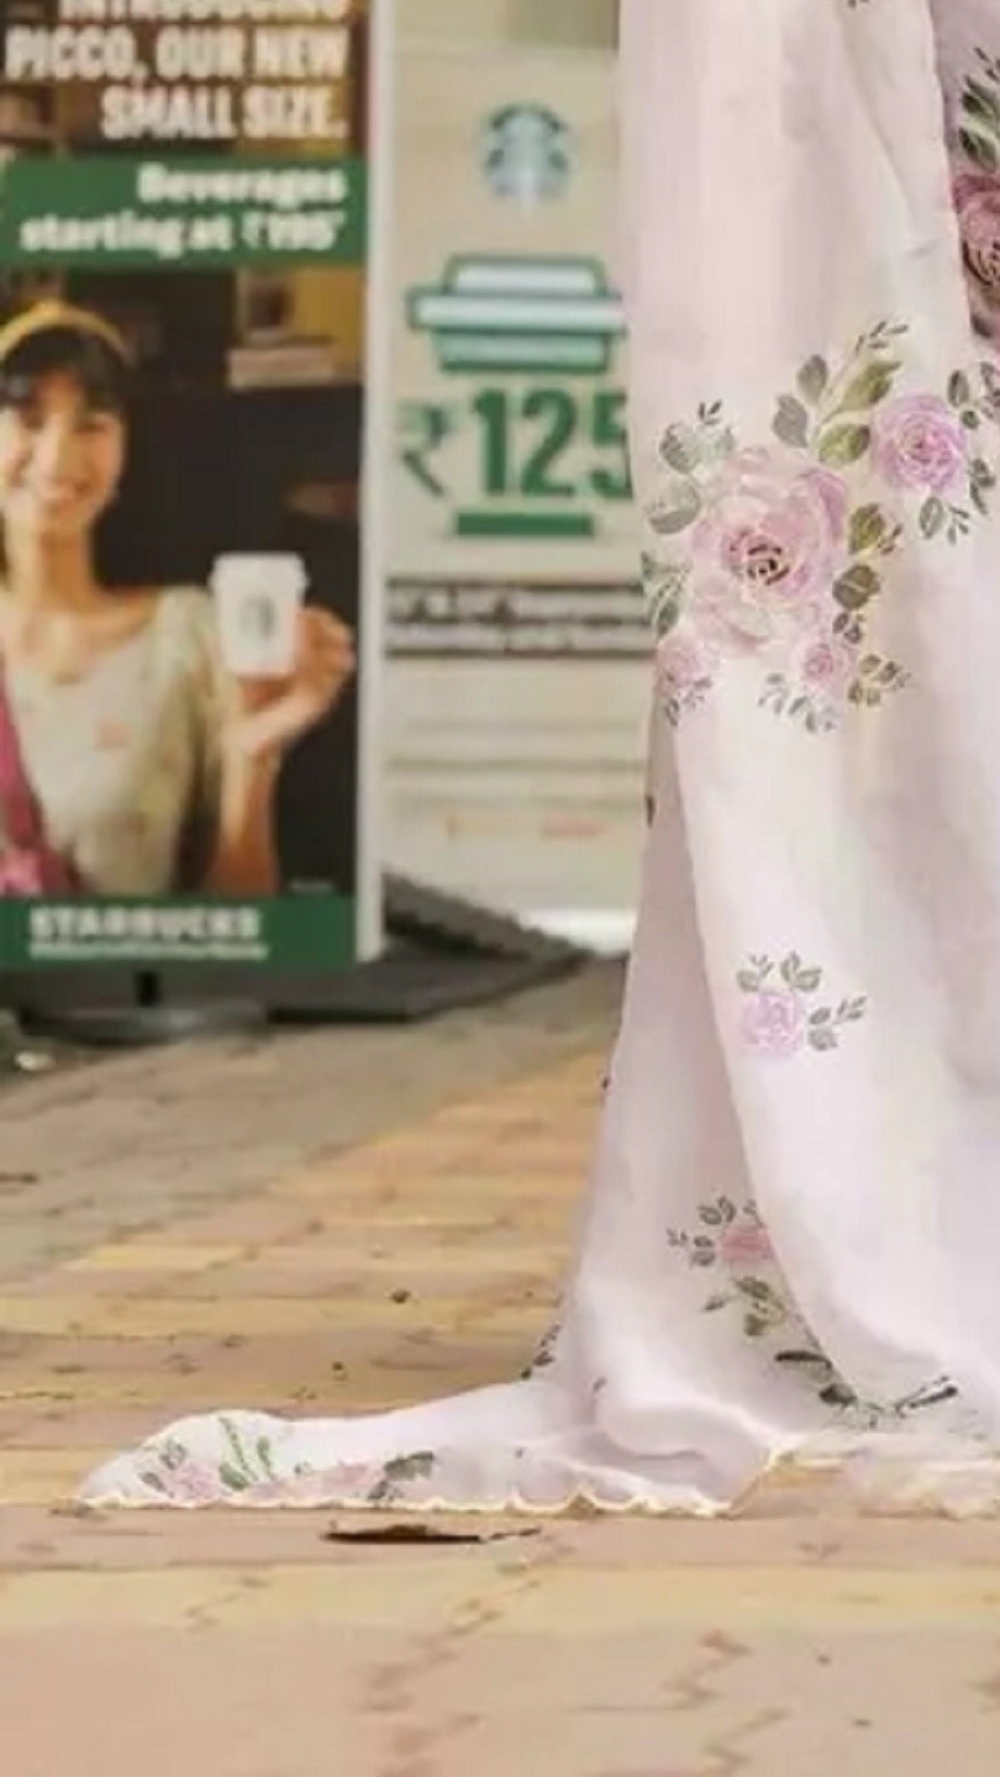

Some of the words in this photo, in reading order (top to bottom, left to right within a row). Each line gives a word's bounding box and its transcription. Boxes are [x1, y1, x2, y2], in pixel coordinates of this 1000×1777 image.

[5, 26, 148, 82] PICCO,
[155, 26, 246, 79] OUR
[253, 26, 350, 79] NEW
[101, 86, 237, 140] SMALL
[242, 86, 348, 139] SIZE.
[137, 162, 346, 207] Beverages
[20, 211, 183, 259] starting
[188, 214, 232, 251] at
[30, 906, 261, 939] STARBUCKS
